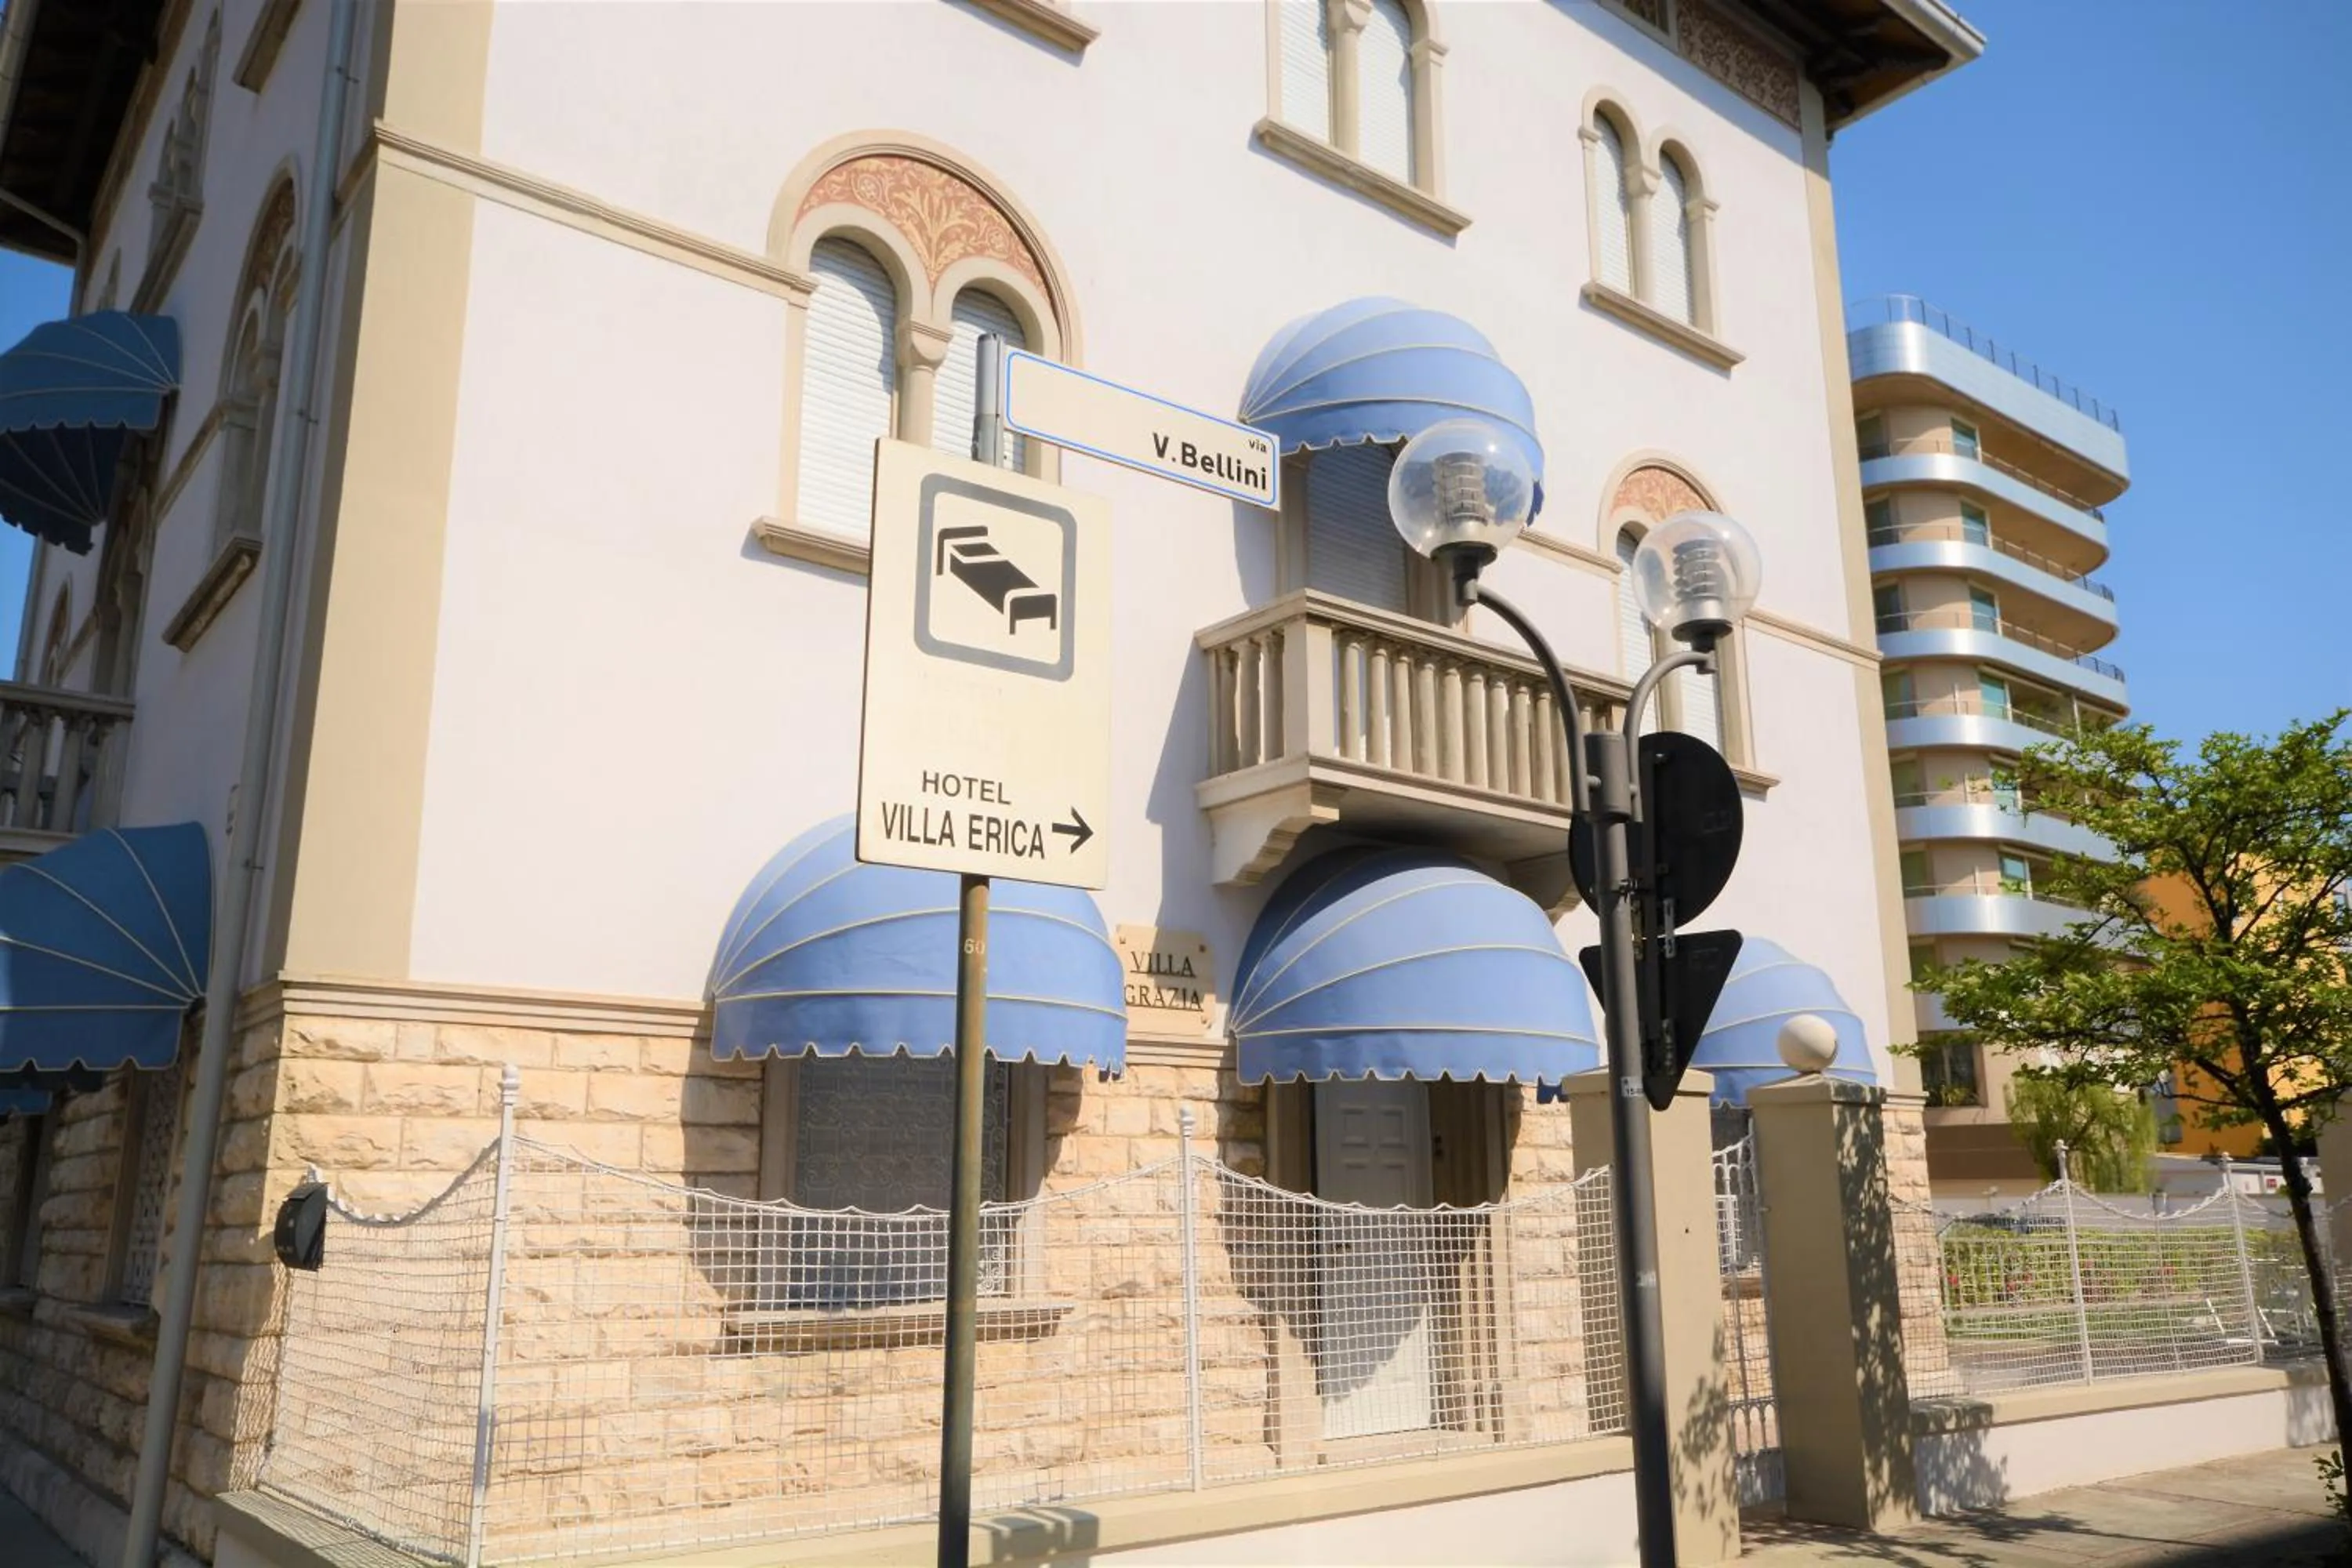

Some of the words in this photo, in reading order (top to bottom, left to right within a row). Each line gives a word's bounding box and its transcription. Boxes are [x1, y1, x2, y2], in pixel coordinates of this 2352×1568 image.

[1248, 437, 1267, 453] via
[1152, 431, 1267, 491] V.Bellini
[921, 770, 1011, 805] HOTEL
[881, 801, 956, 848] VILLA
[967, 813, 1045, 859] ERICA
[1130, 951, 1196, 978] VILLA
[1123, 984, 1204, 1011] GRAZIA
